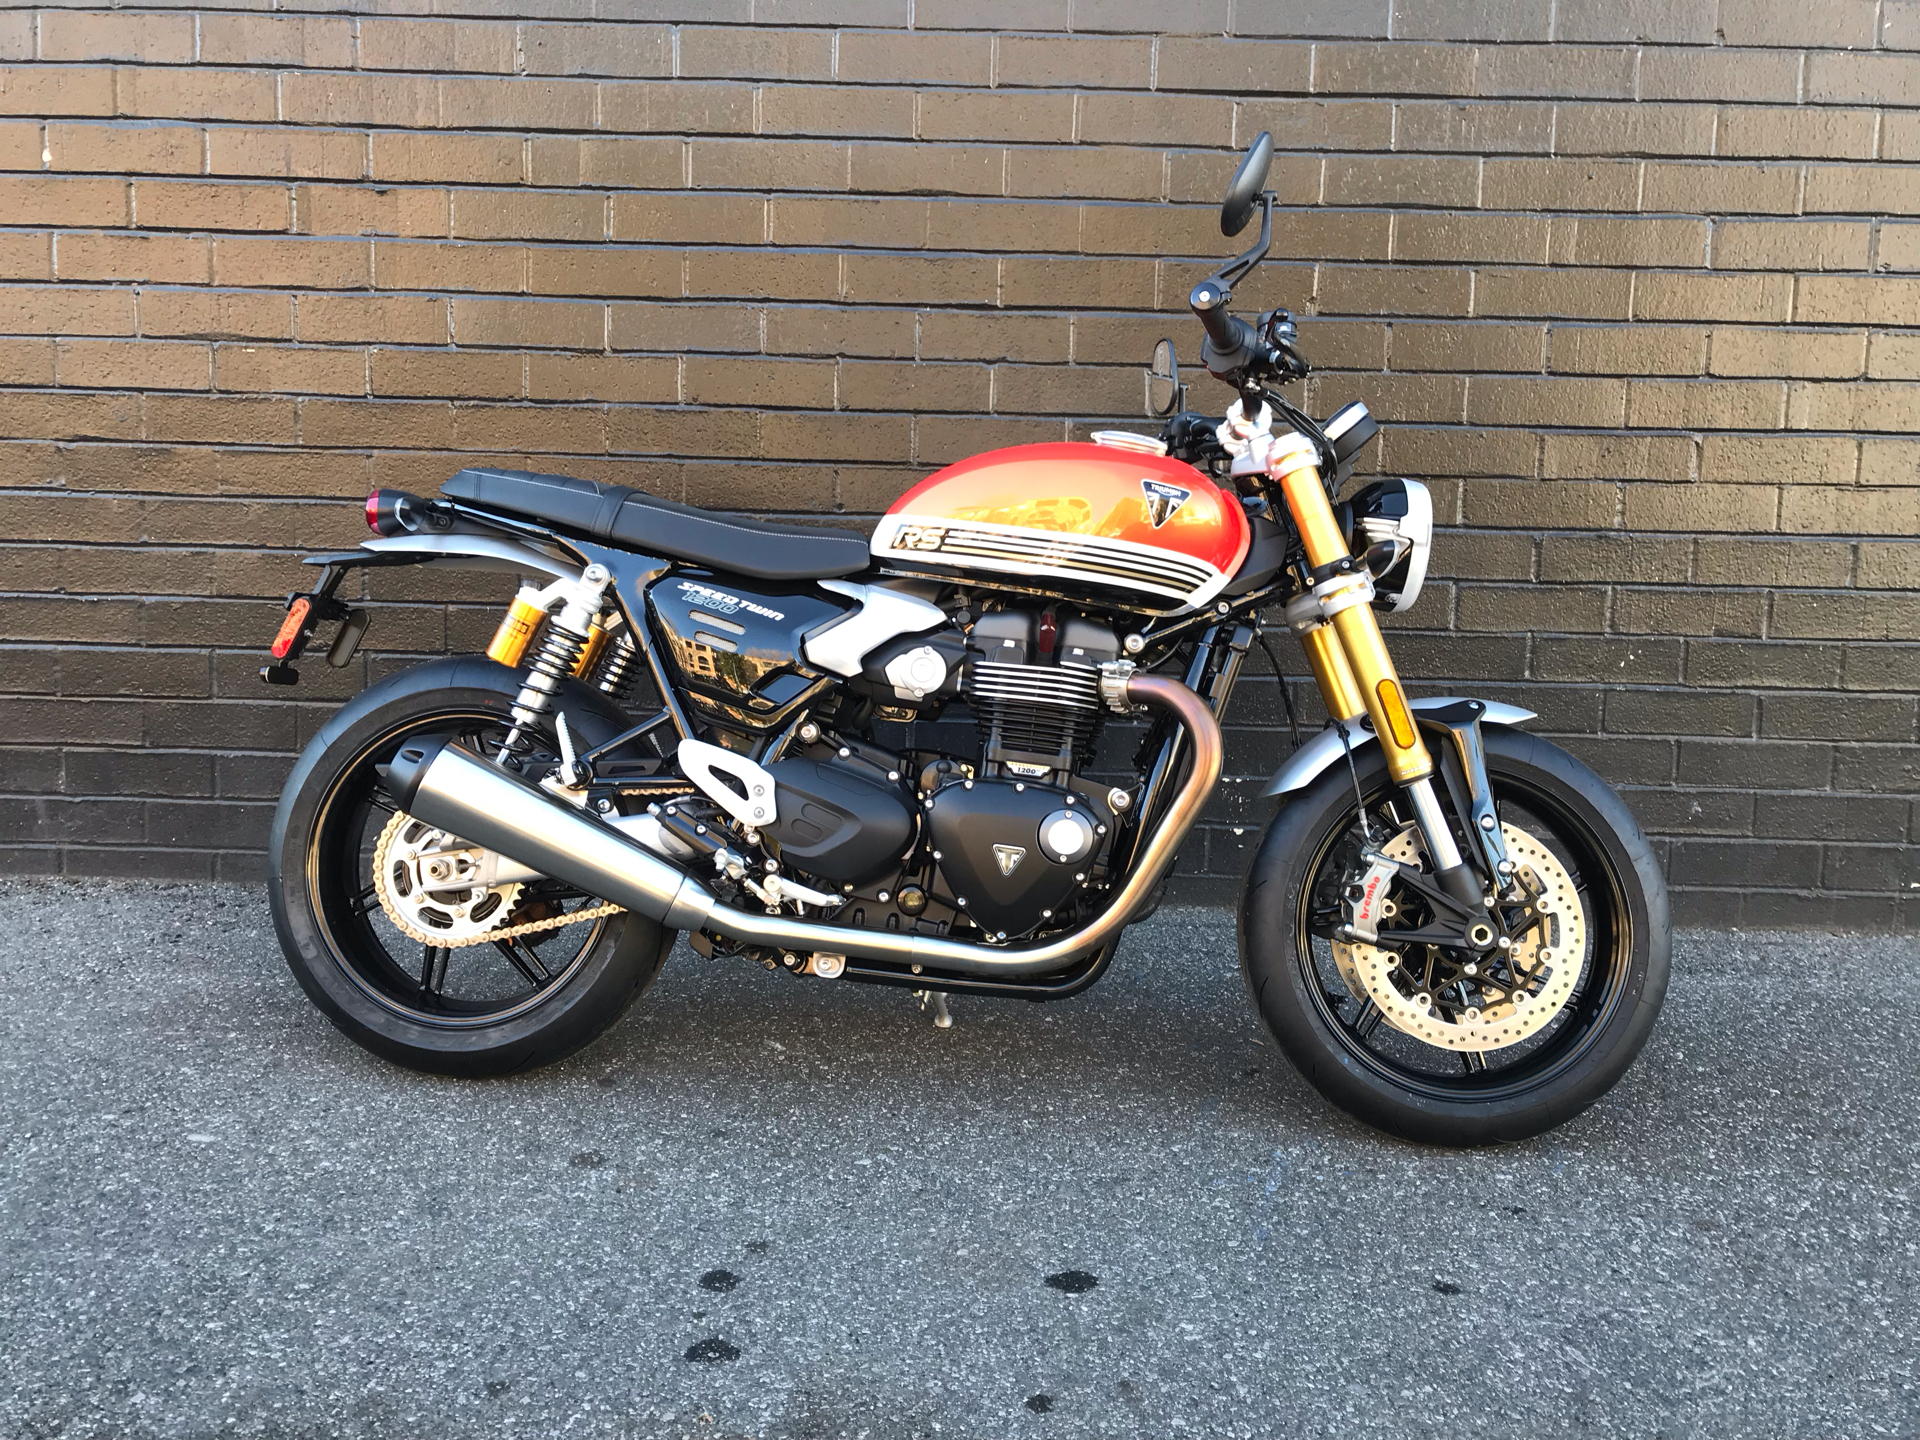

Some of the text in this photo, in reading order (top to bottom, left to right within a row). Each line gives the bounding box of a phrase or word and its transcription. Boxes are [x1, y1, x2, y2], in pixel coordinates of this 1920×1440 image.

[1151, 483, 1181, 497] TRIUMPH
[892, 526, 946, 550] RS
[677, 581, 785, 621] SPEED TWIN
[682, 591, 739, 615] 1200
[1017, 766, 1036, 775] 1200
[1359, 876, 1381, 920] brembo
